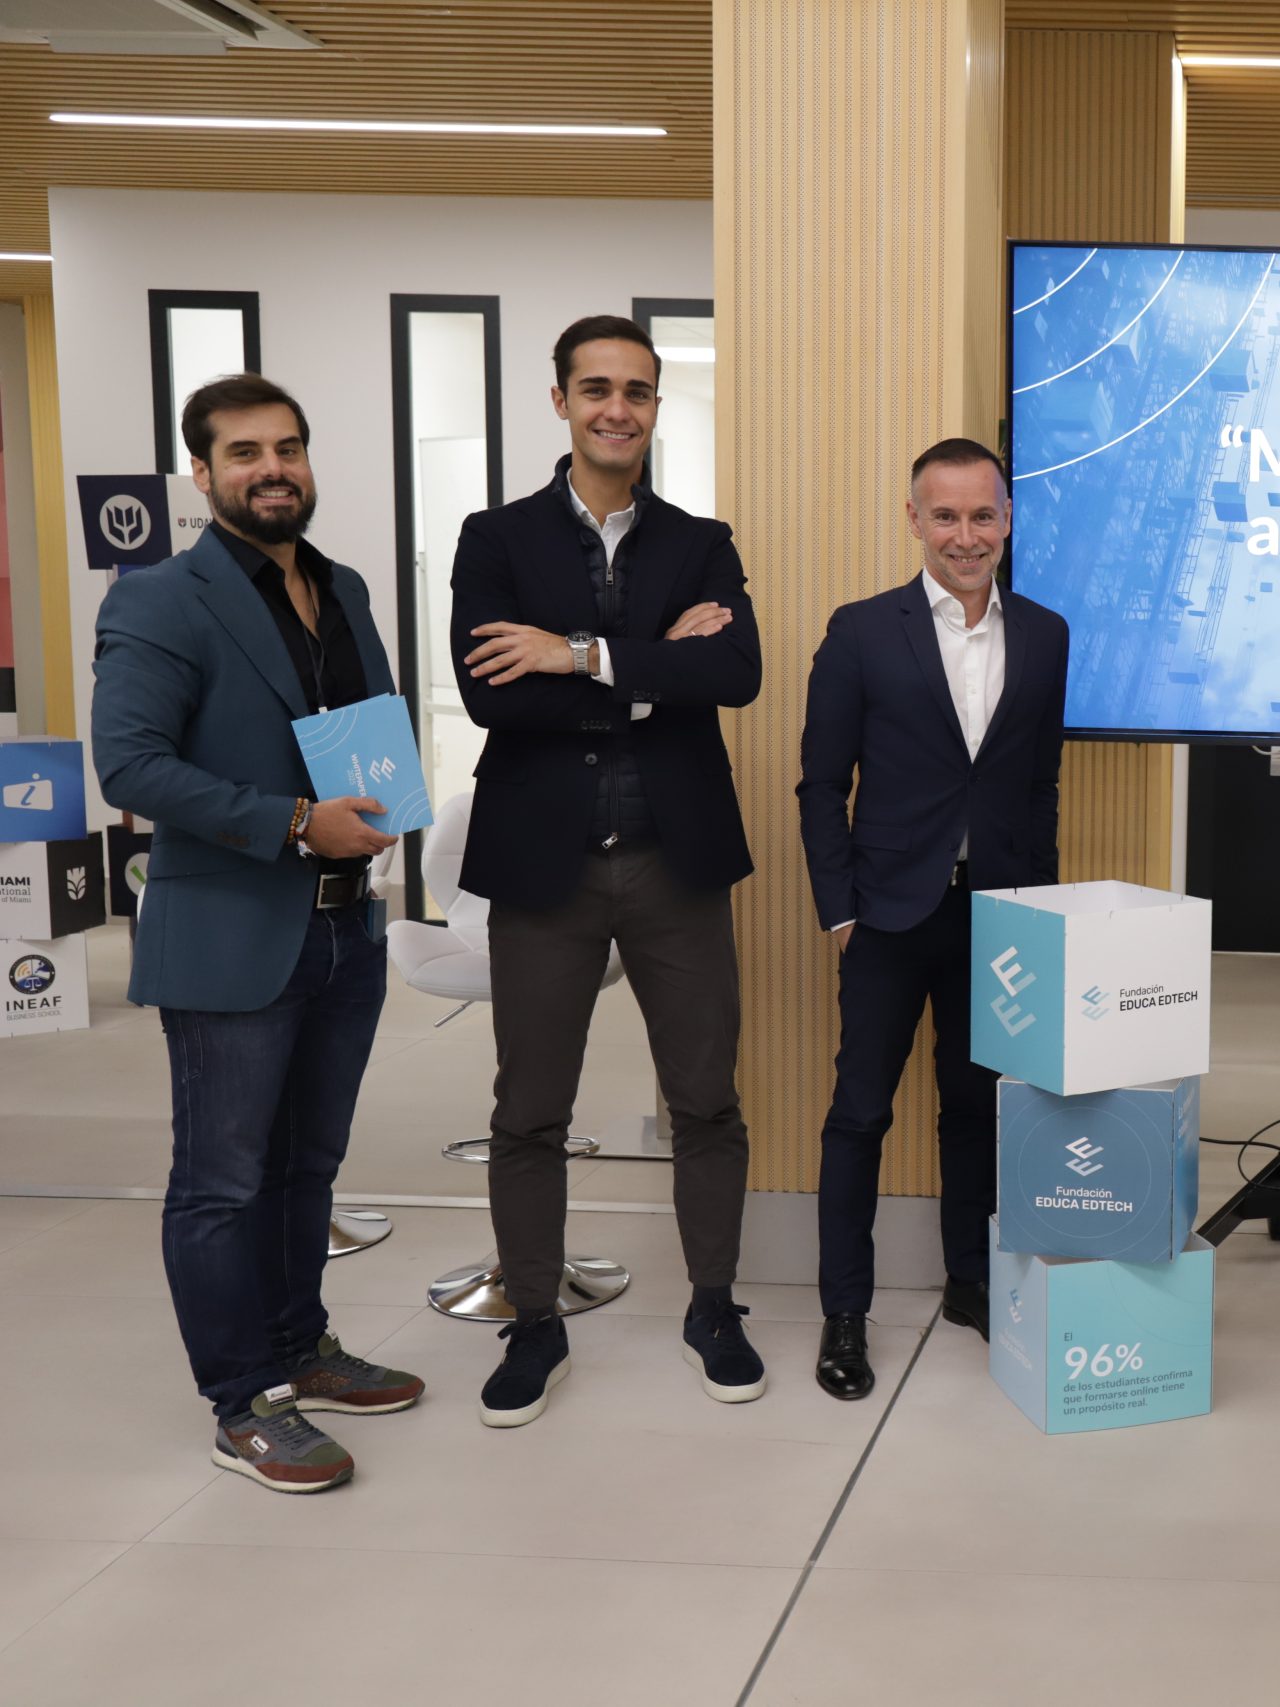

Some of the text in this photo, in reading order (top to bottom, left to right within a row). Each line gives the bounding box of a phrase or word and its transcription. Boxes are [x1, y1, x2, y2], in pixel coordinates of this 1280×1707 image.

[190, 517, 213, 529] UDA
[0, 876, 31, 886] IAMI
[1119, 984, 1164, 998] Fundación
[6, 995, 63, 1012] INEAF
[1119, 990, 1199, 1012] EDUCA EDTECH
[1056, 1186, 1113, 1199] Fundación
[1035, 1196, 1134, 1213] EDUCA EDTECH
[1063, 1332, 1074, 1342] El
[1064, 1342, 1144, 1380] 96%
[1063, 1369, 1193, 1393] de los estudiantes confirma
[1063, 1381, 1185, 1405] que formarse online tiene
[1063, 1398, 1148, 1415] un propósito real.
